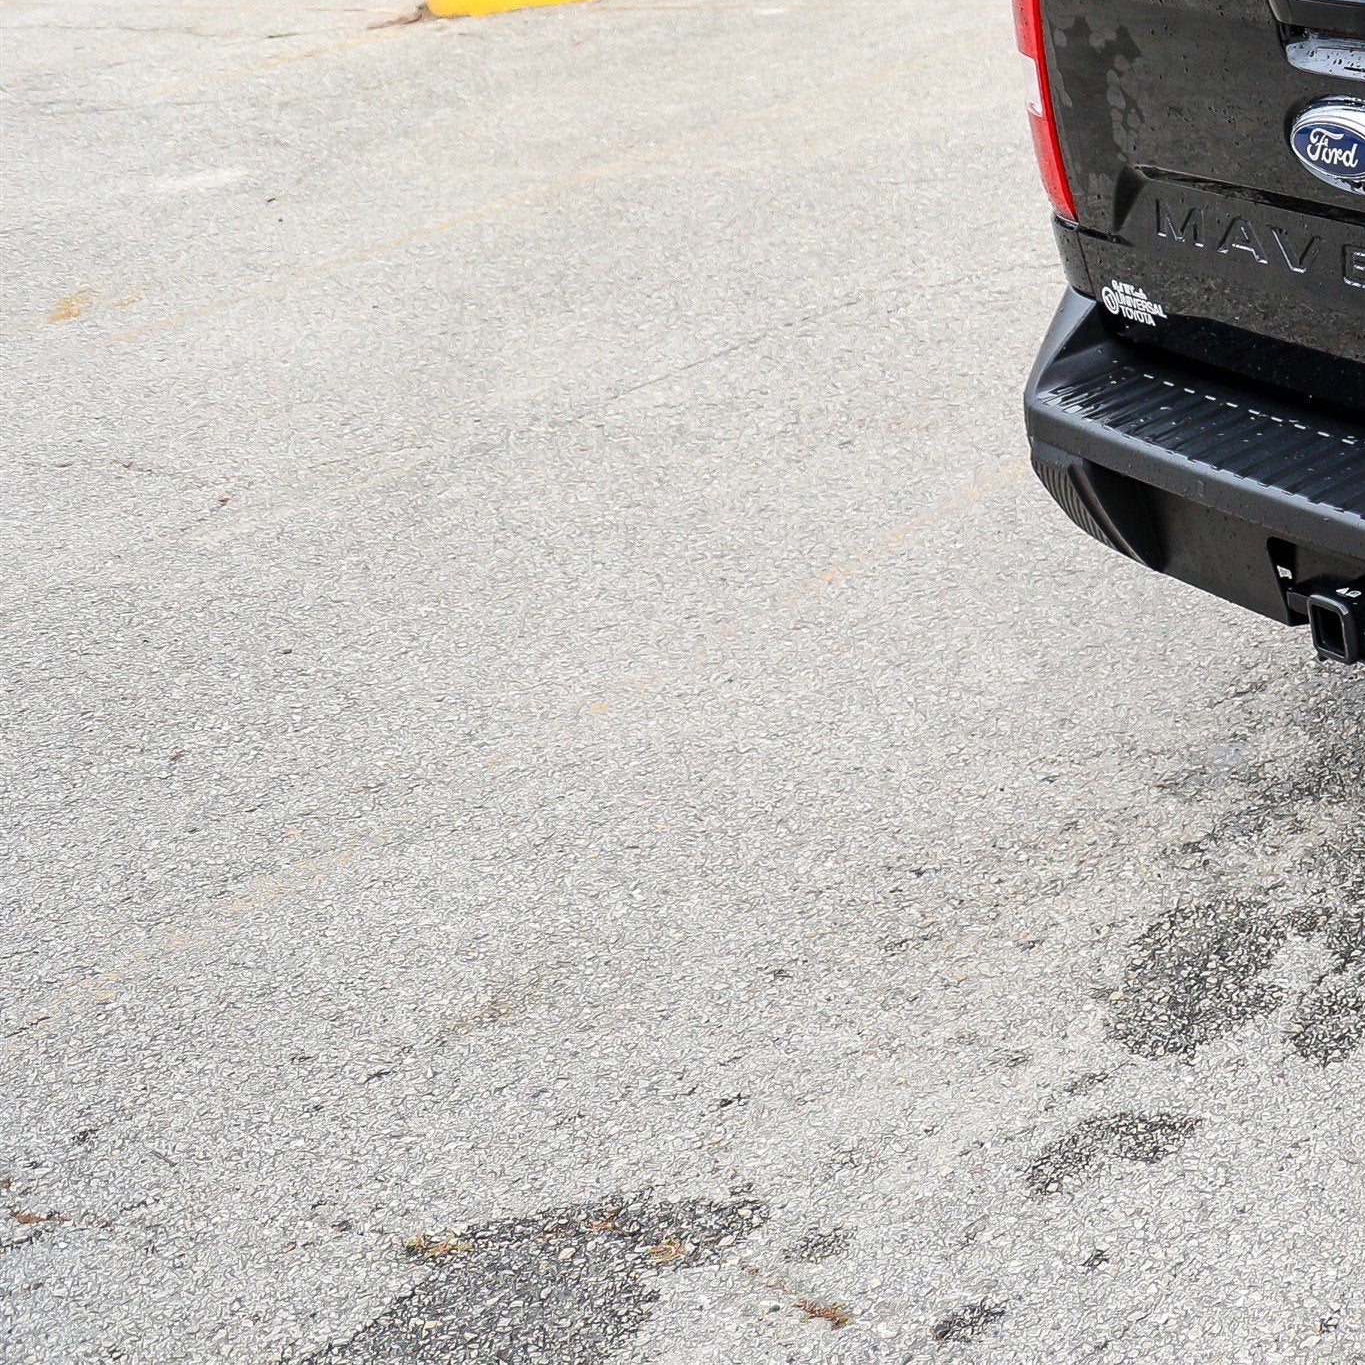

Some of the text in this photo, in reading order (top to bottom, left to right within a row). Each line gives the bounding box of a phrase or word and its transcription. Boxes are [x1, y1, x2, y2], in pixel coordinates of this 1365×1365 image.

[1306, 128, 1359, 168] Ford
[1115, 292, 1168, 319] UNIVERSAL
[1119, 305, 1156, 327] TOYOTA
